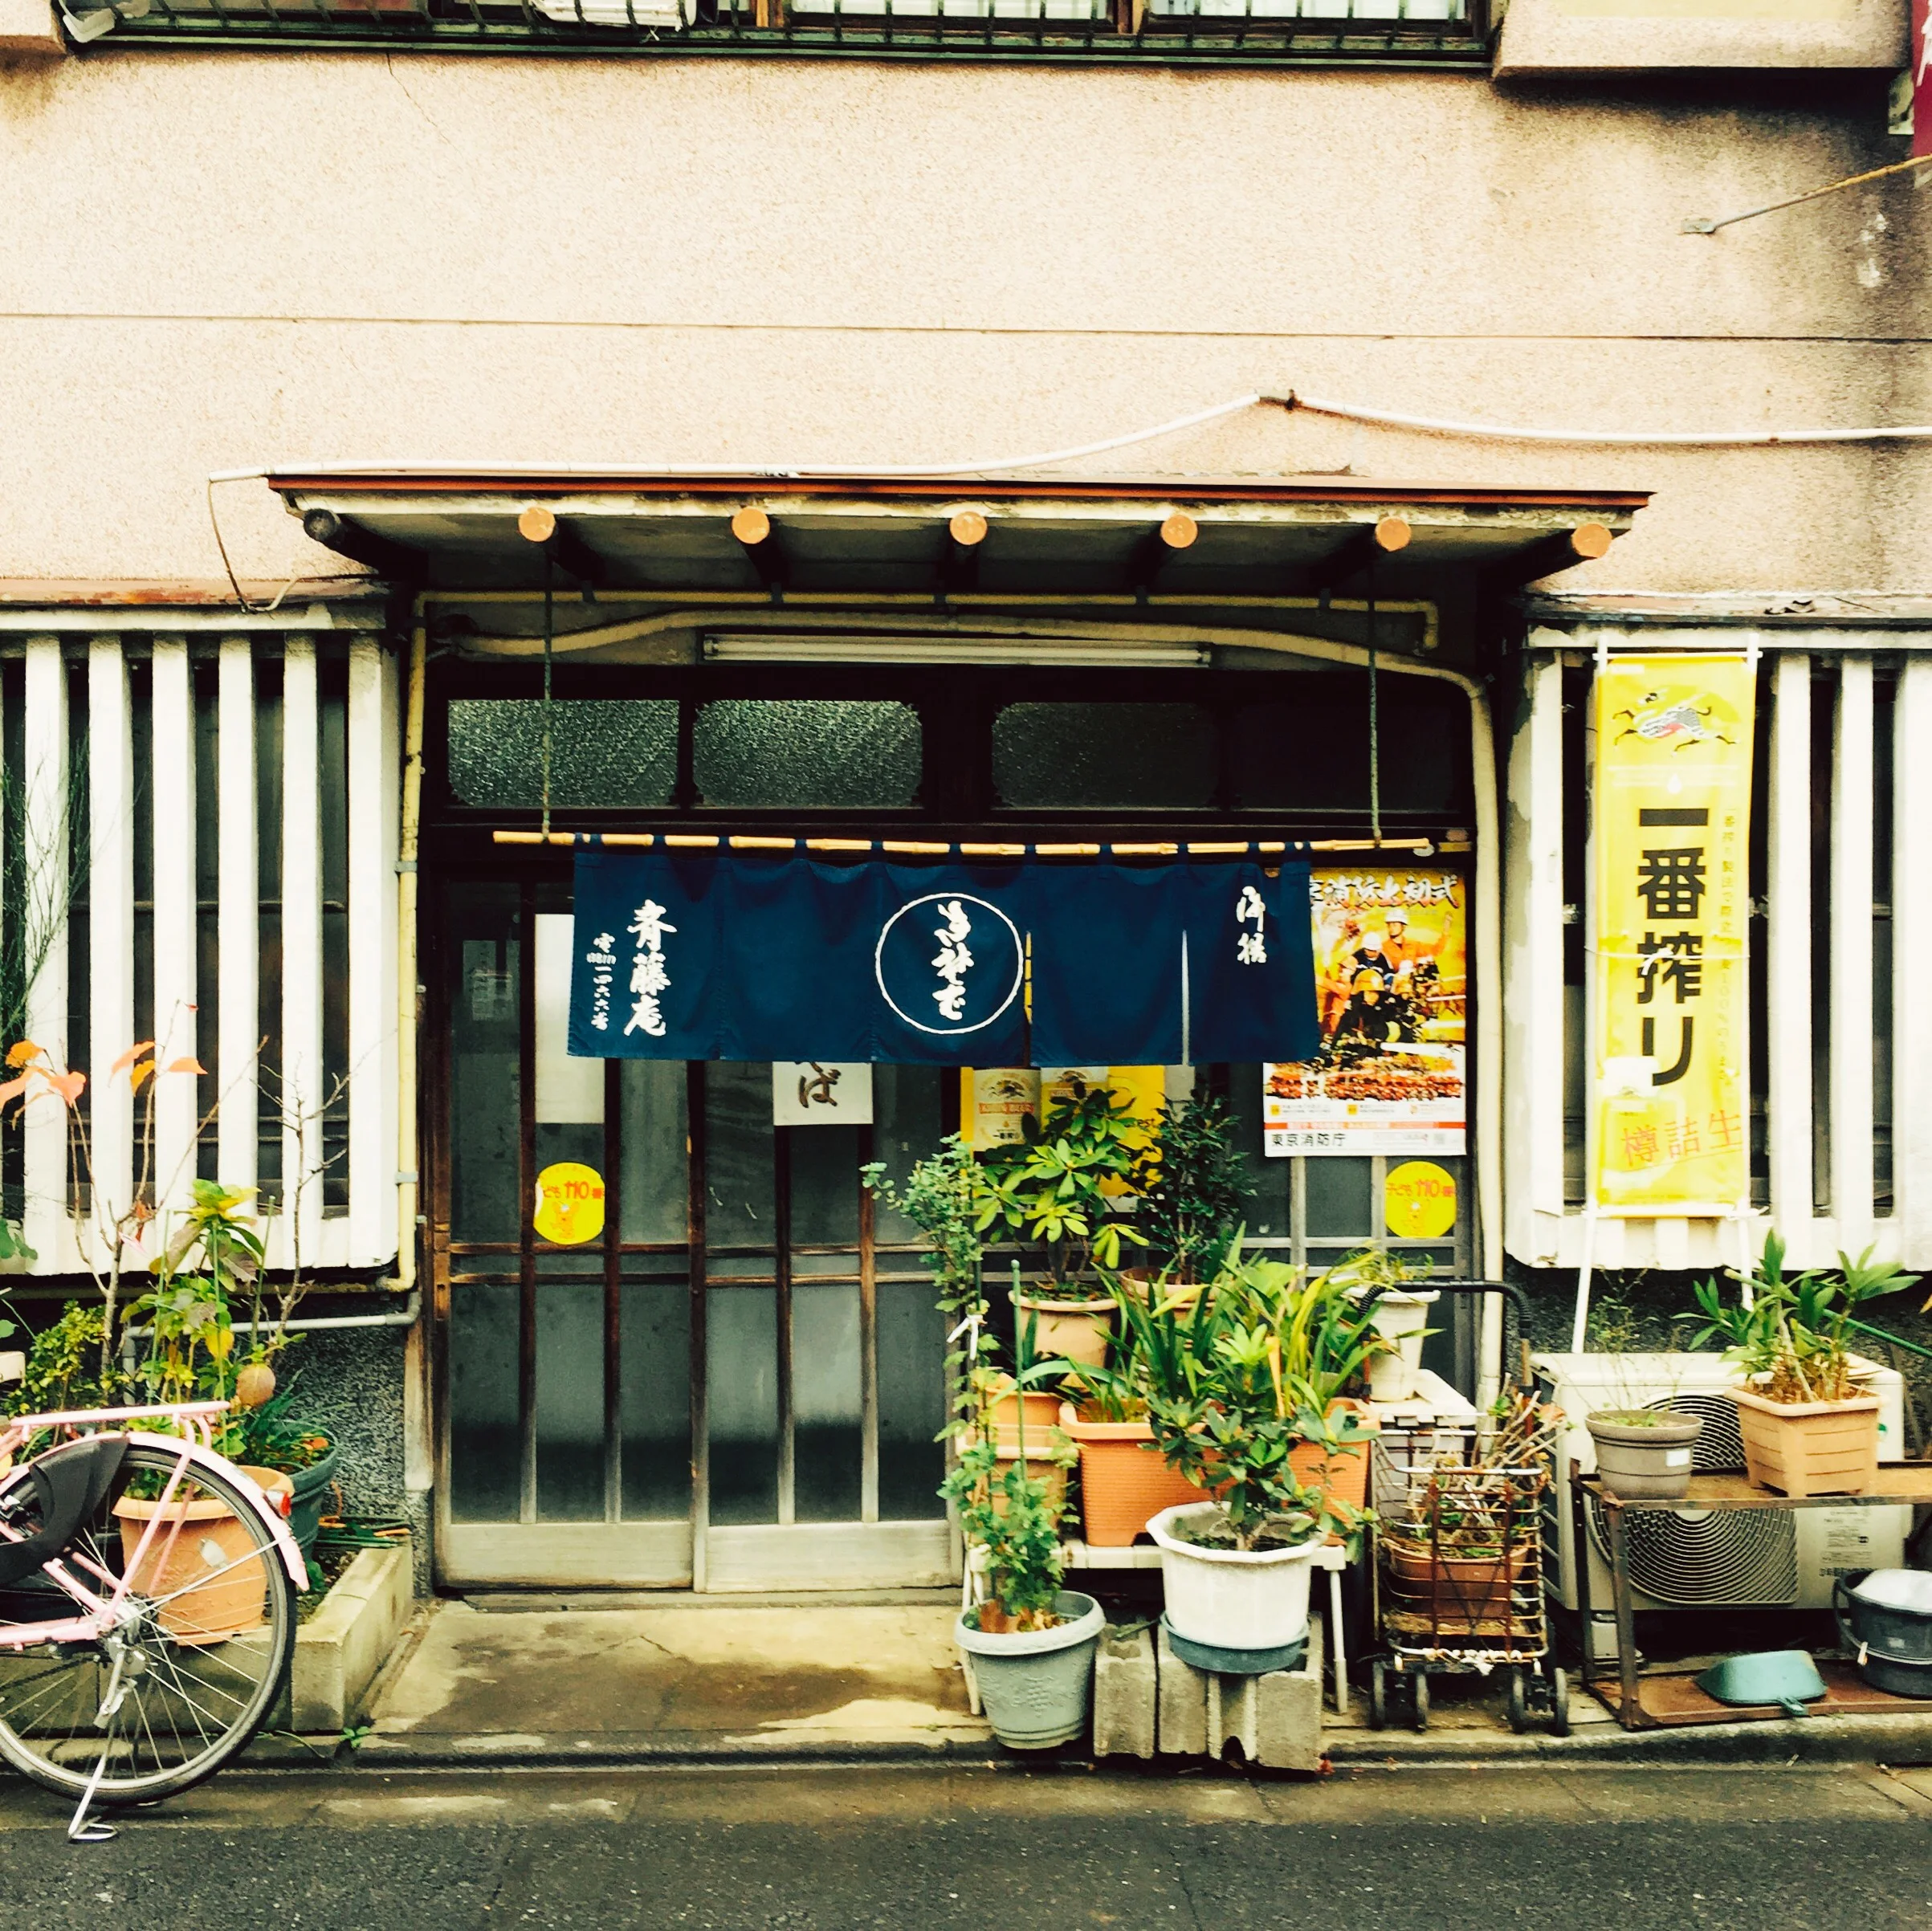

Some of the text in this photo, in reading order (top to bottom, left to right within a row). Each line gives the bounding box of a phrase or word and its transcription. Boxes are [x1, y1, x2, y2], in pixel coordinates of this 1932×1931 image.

[1637, 809, 1709, 1087] 一番搾り
[1271, 1132, 1346, 1147] 東京消防庁
[1621, 1110, 1742, 1167] 樽詰生
